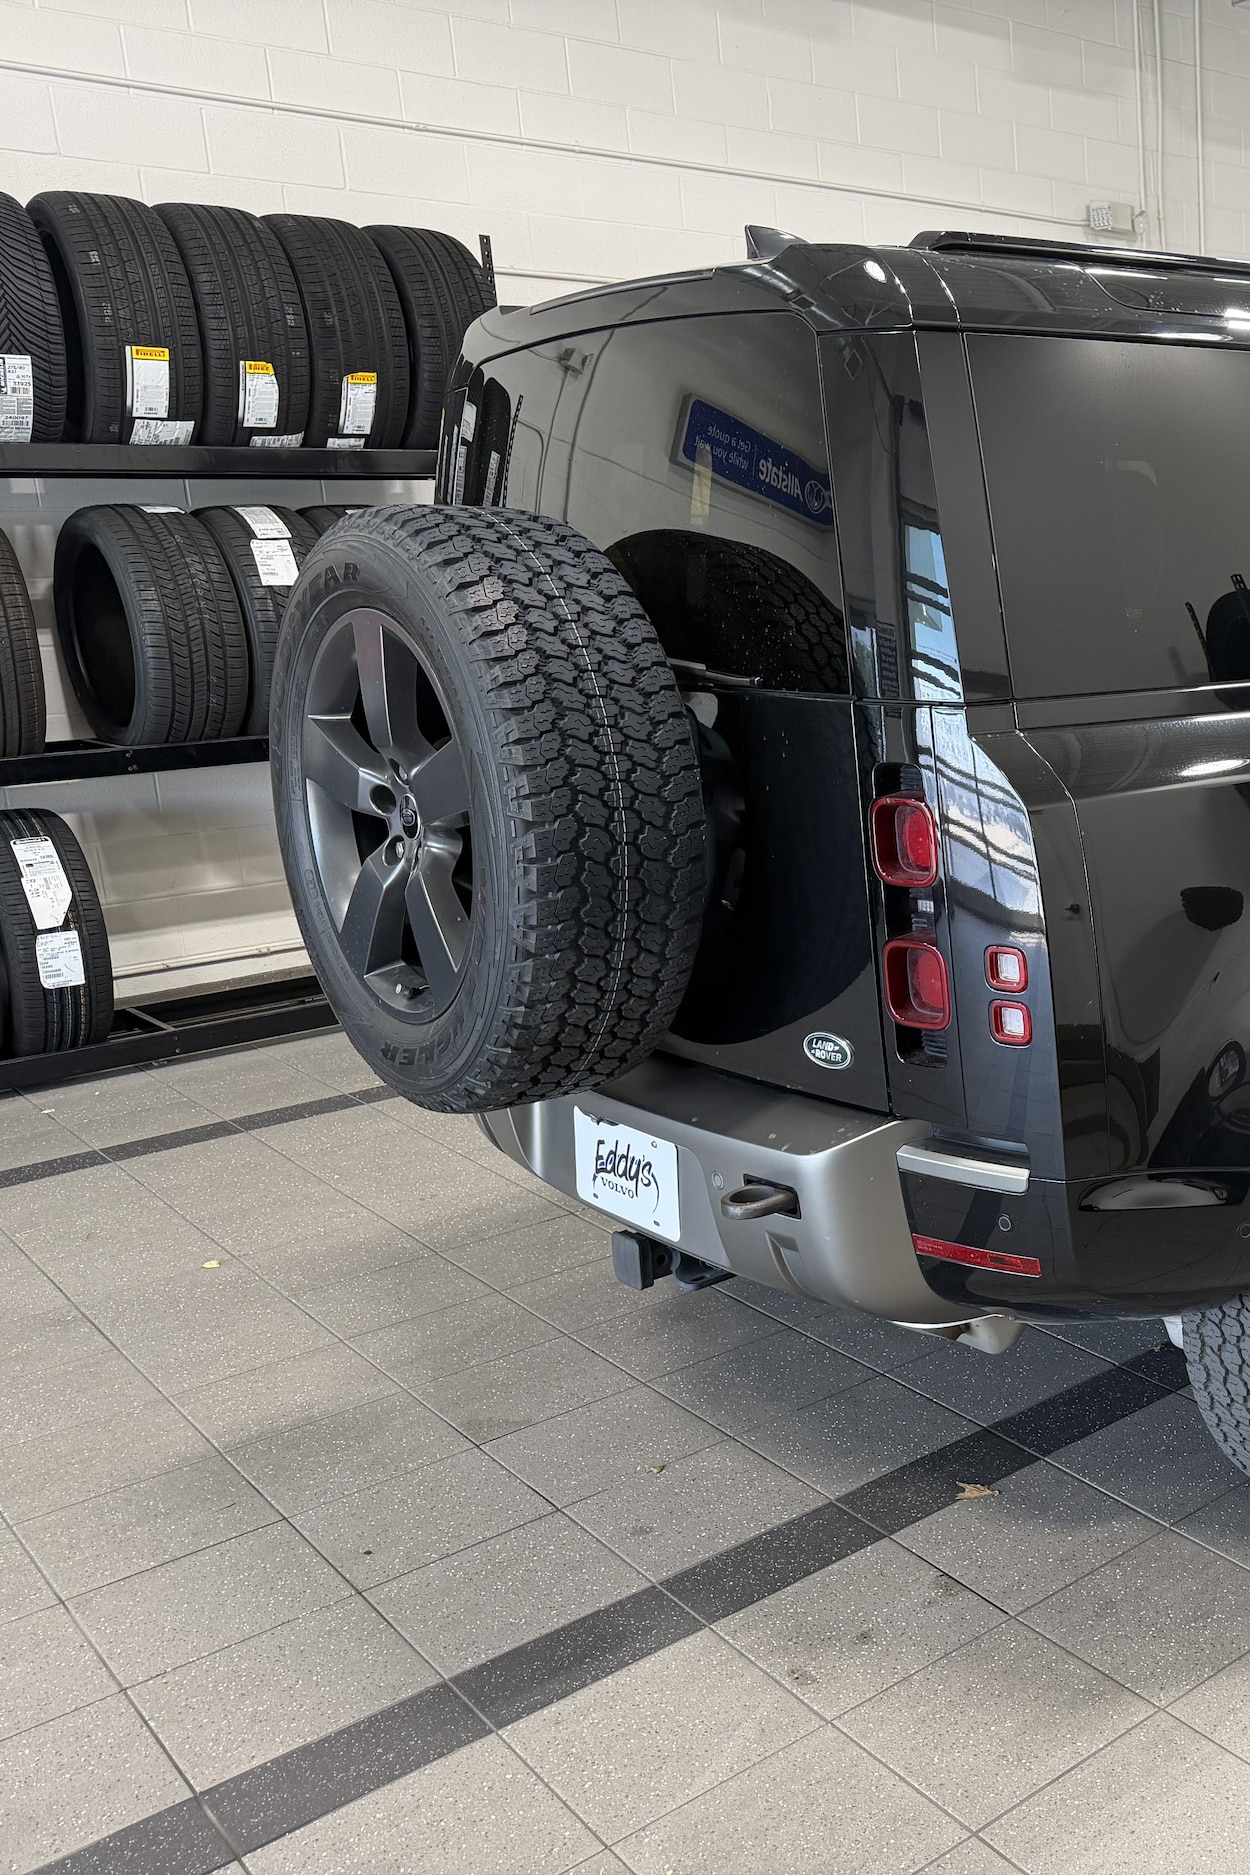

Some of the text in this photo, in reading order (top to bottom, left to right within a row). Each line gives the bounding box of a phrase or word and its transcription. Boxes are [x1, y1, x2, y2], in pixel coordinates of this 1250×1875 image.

[811, 1038, 836, 1052] LAND
[814, 1048, 843, 1063] ROVER
[594, 1138, 654, 1199] Eddy's
[600, 1175, 635, 1200] VOLVO
